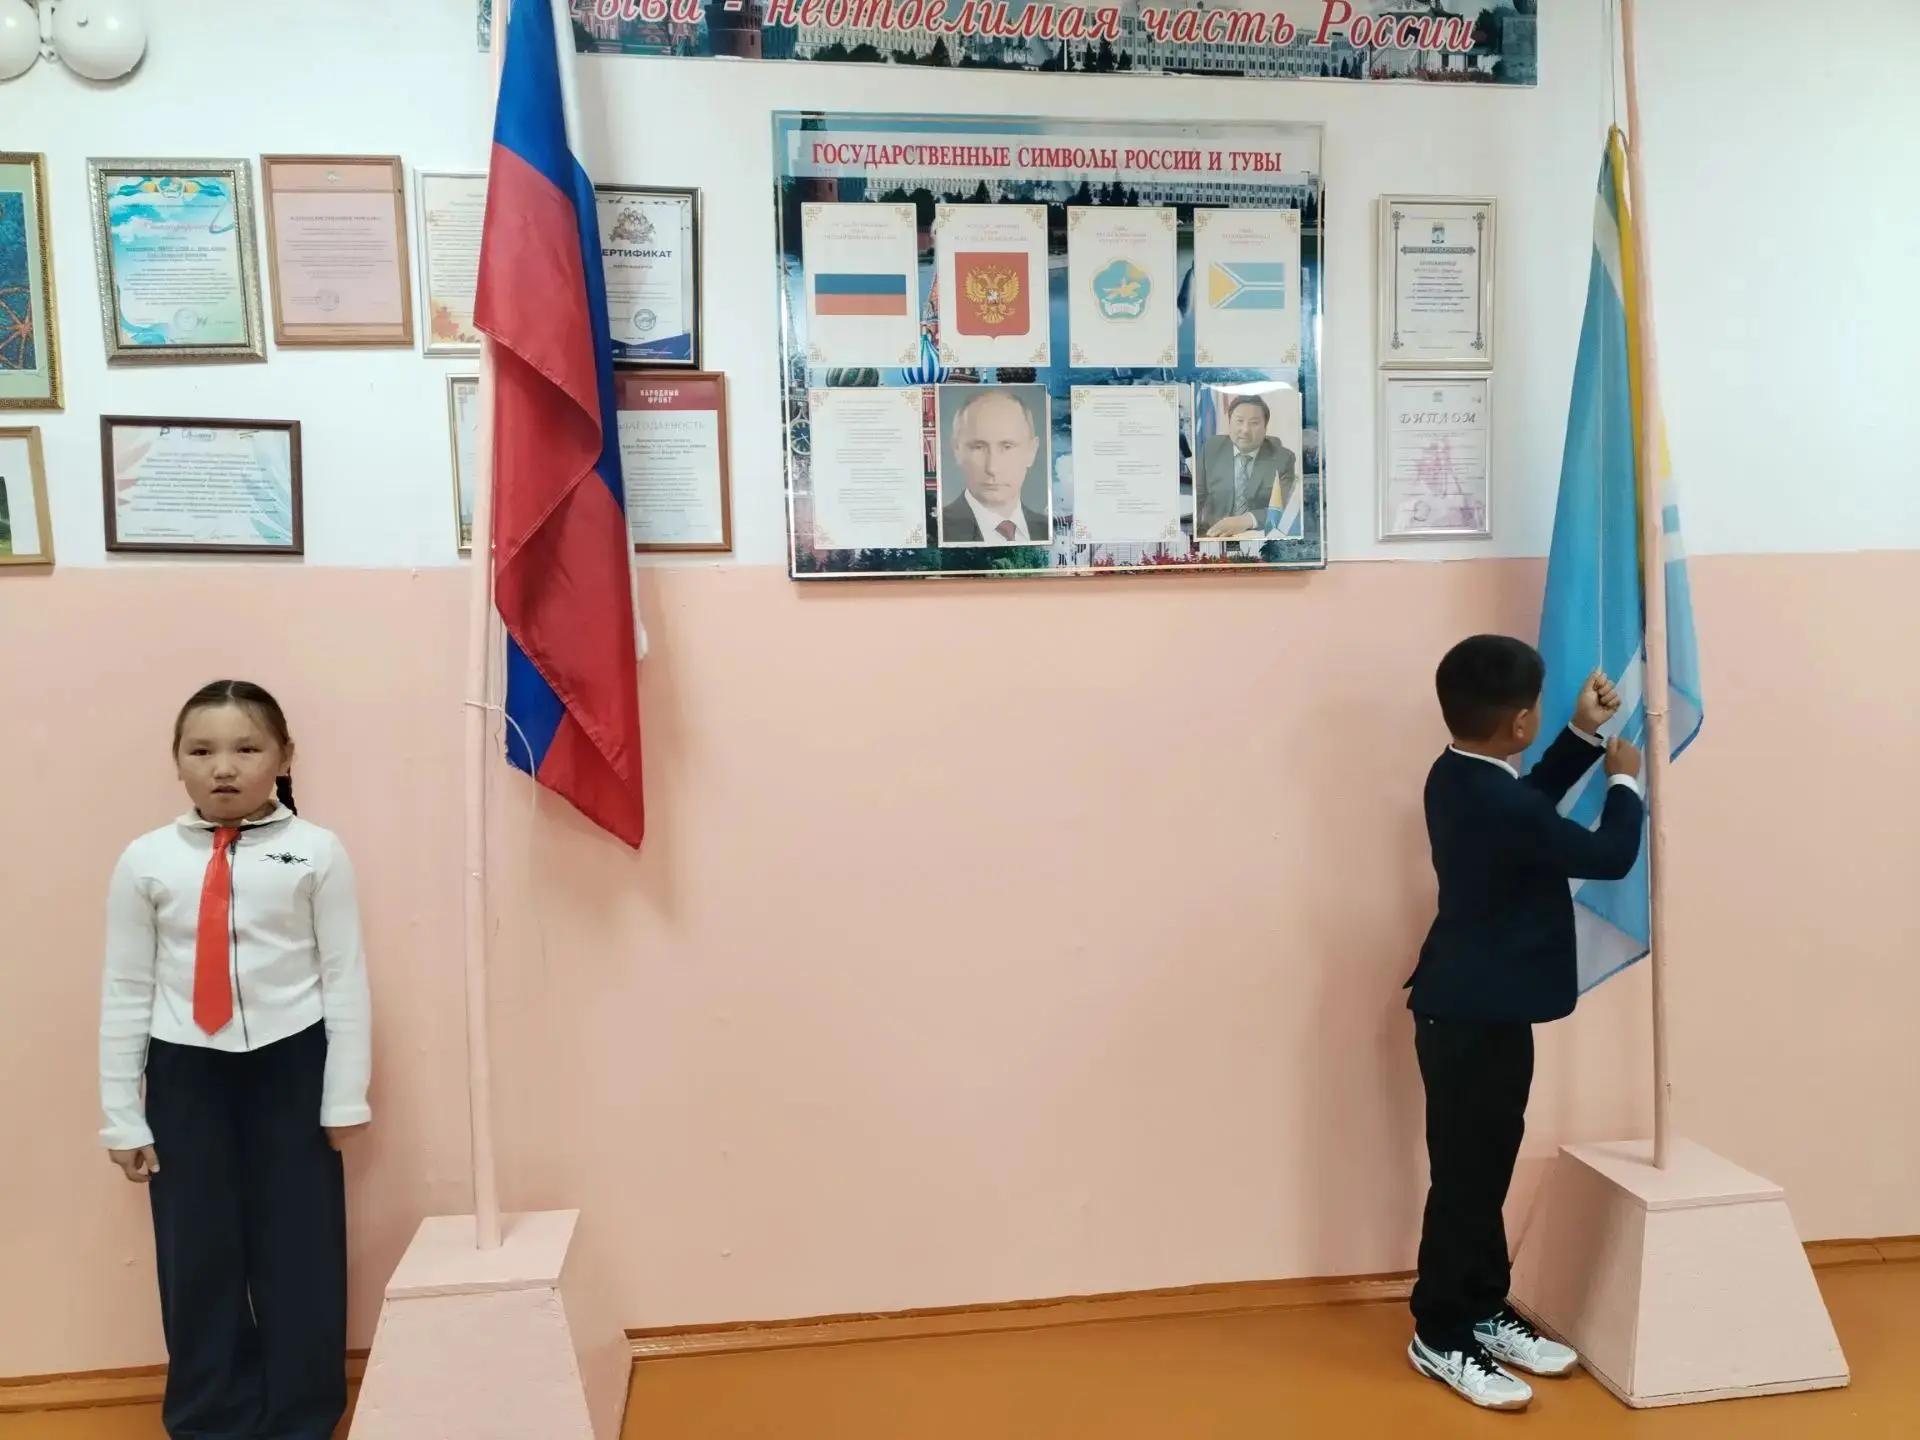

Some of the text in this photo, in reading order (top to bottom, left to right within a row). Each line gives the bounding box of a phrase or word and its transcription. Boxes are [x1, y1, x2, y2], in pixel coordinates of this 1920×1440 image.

[568, 0, 705, 22] ыва
[1142, 7, 1295, 44] часть
[1311, 0, 1476, 51] России
[812, 143, 1282, 172] ГОСУДАРСТВЕННЫЕ СИМВОЛЫ РОССИИ И ТУВЫ
[601, 248, 673, 258] ЕРТИФИКАТ
[1400, 412, 1477, 424] ДИПЛОМ
